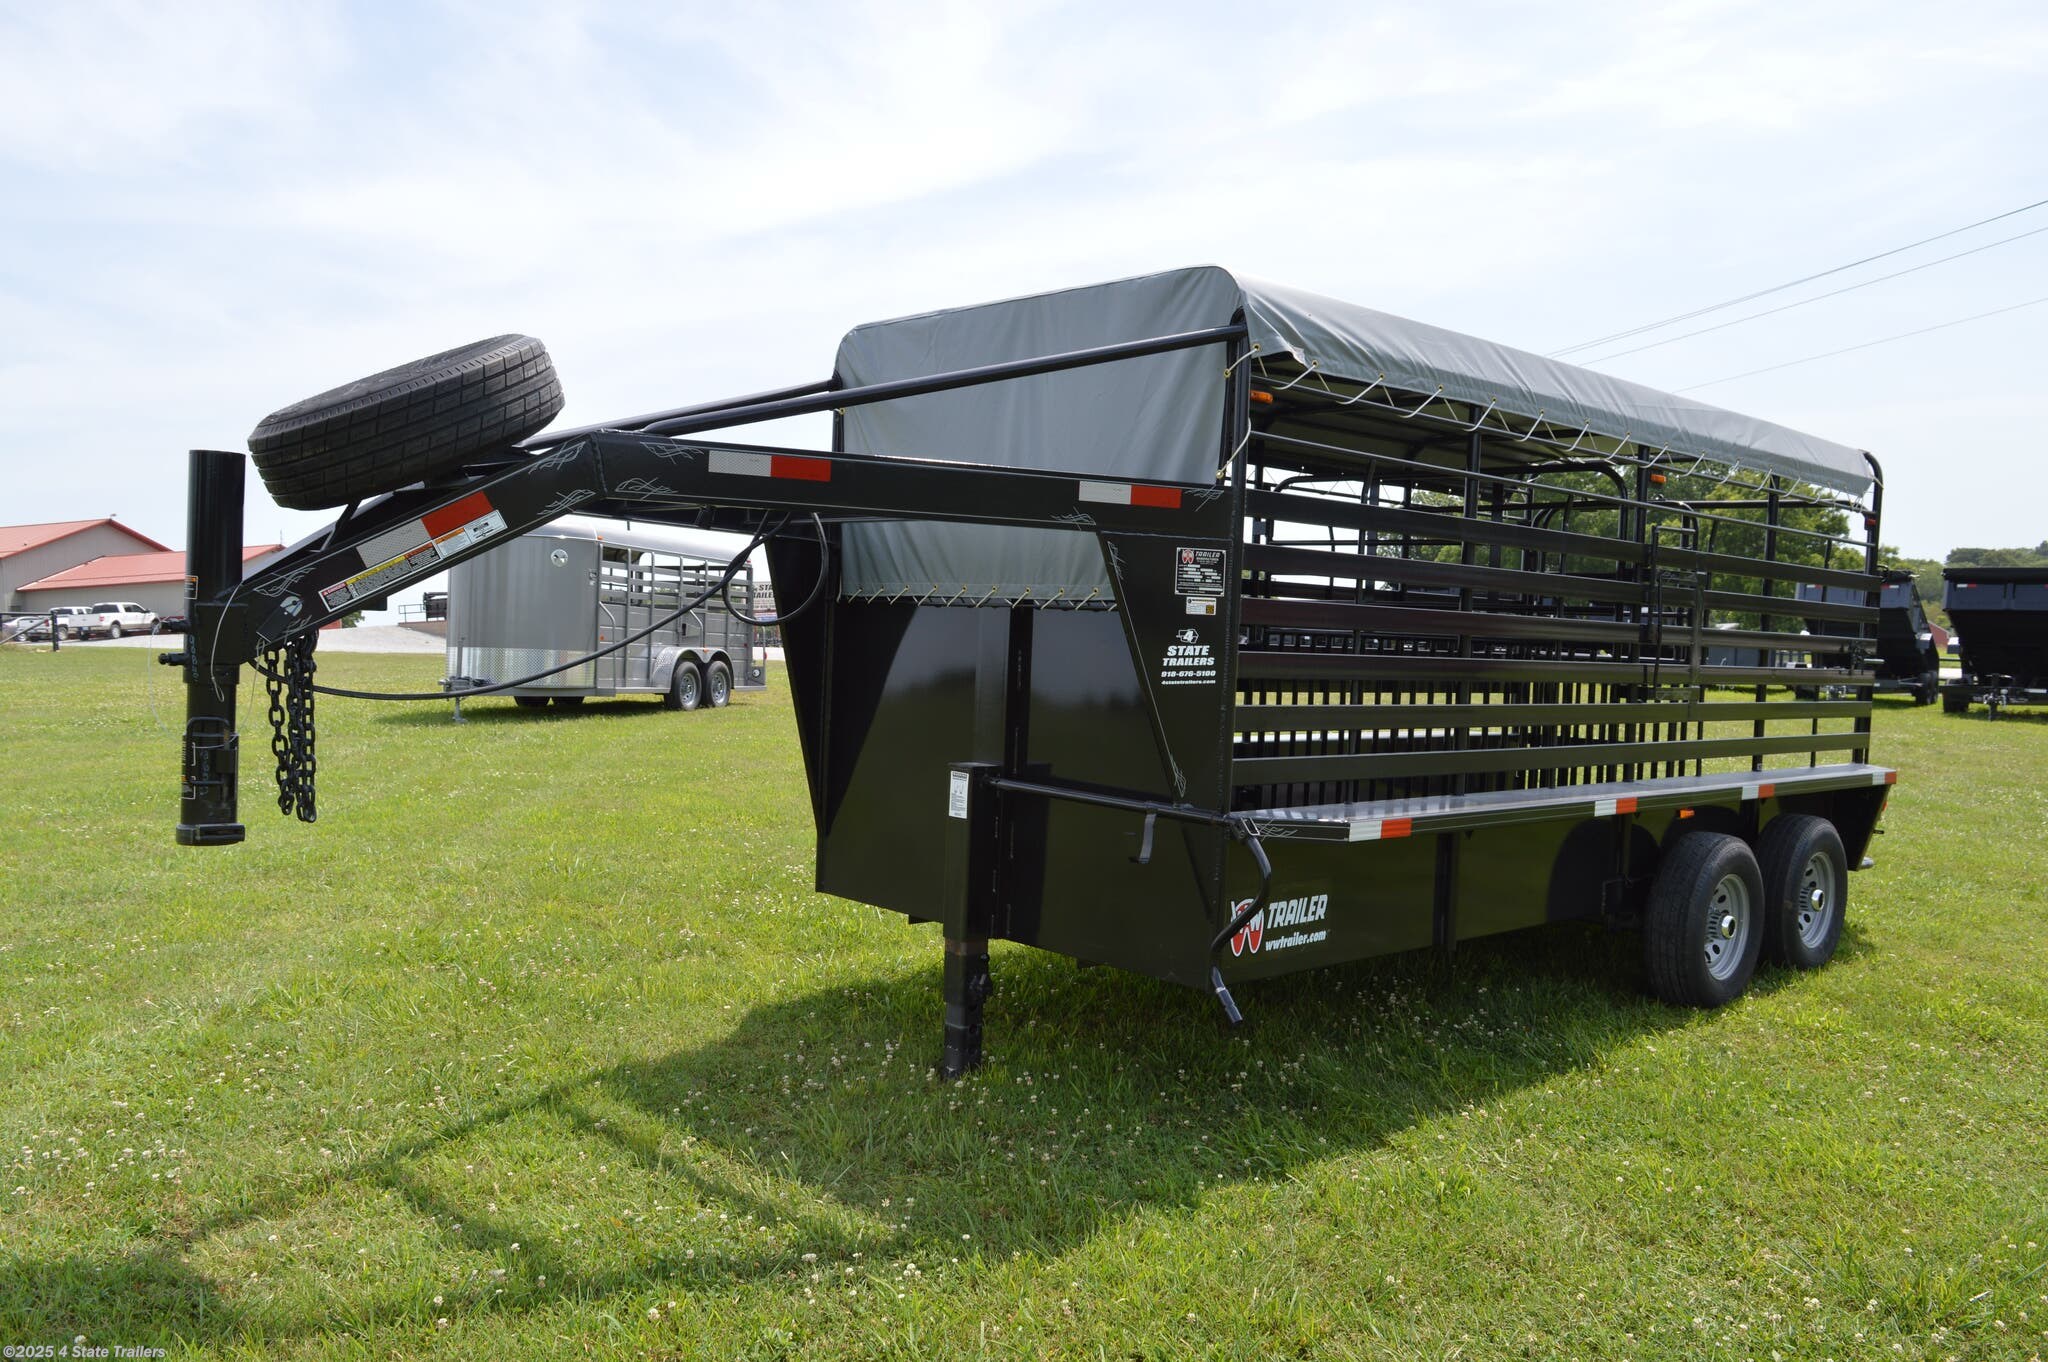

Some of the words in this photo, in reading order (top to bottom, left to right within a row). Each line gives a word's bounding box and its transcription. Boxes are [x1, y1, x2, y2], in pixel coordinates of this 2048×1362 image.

[1183, 630, 1194, 643] 4
[1167, 645, 1210, 656] STATE
[1162, 657, 1215, 666] TRAILERS
[1267, 894, 1328, 929] TRAILER
[1265, 930, 1327, 951] wwtrailer.com
